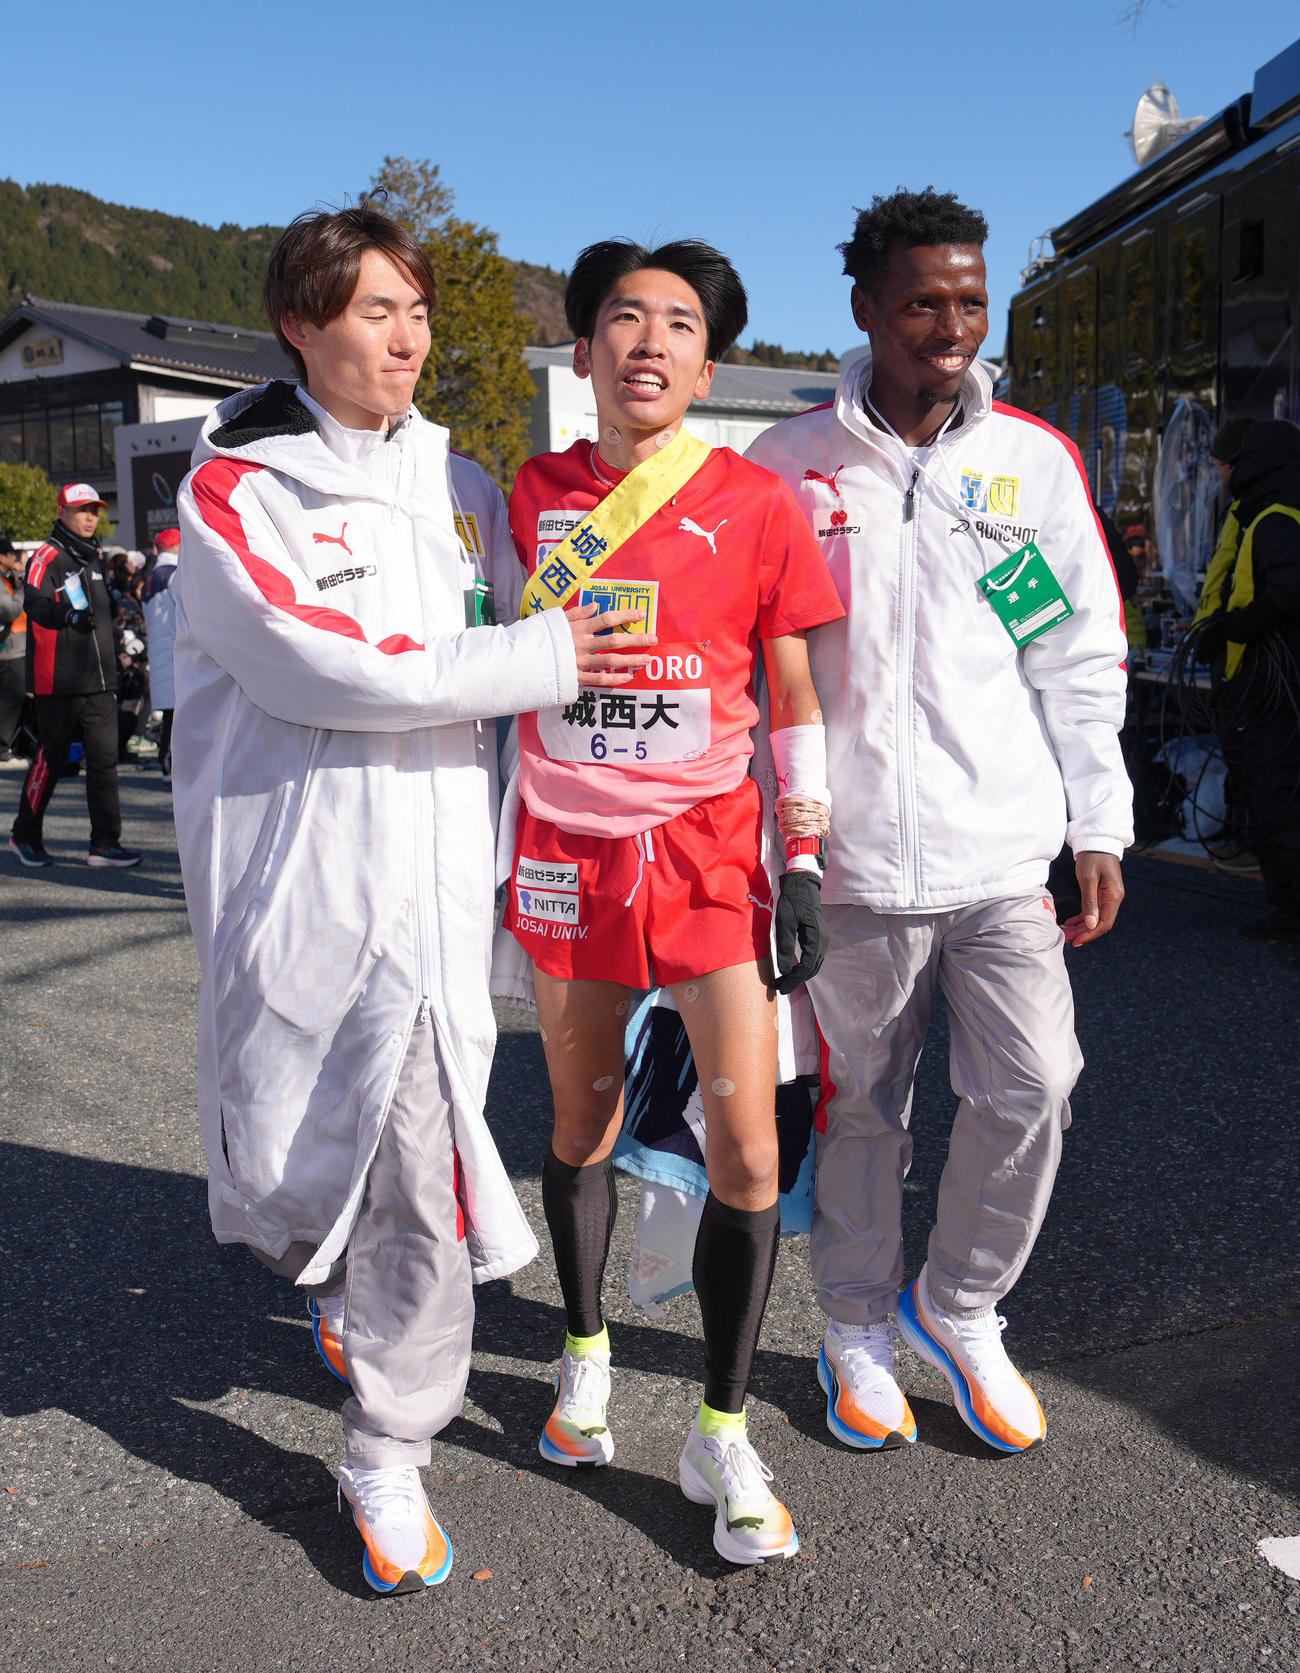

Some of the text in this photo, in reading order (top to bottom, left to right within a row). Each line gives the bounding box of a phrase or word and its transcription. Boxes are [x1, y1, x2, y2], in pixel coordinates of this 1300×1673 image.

[315, 564, 378, 592] 新田ゼラチン
[524, 524, 608, 619] 城西大
[611, 586, 651, 594] UNIVERSITY
[562, 691, 680, 731] 城西大
[518, 864, 578, 883] 新田ゼラチン
[534, 898, 577, 915] NITTA
[516, 916, 589, 940] JOSAI UNIV.
